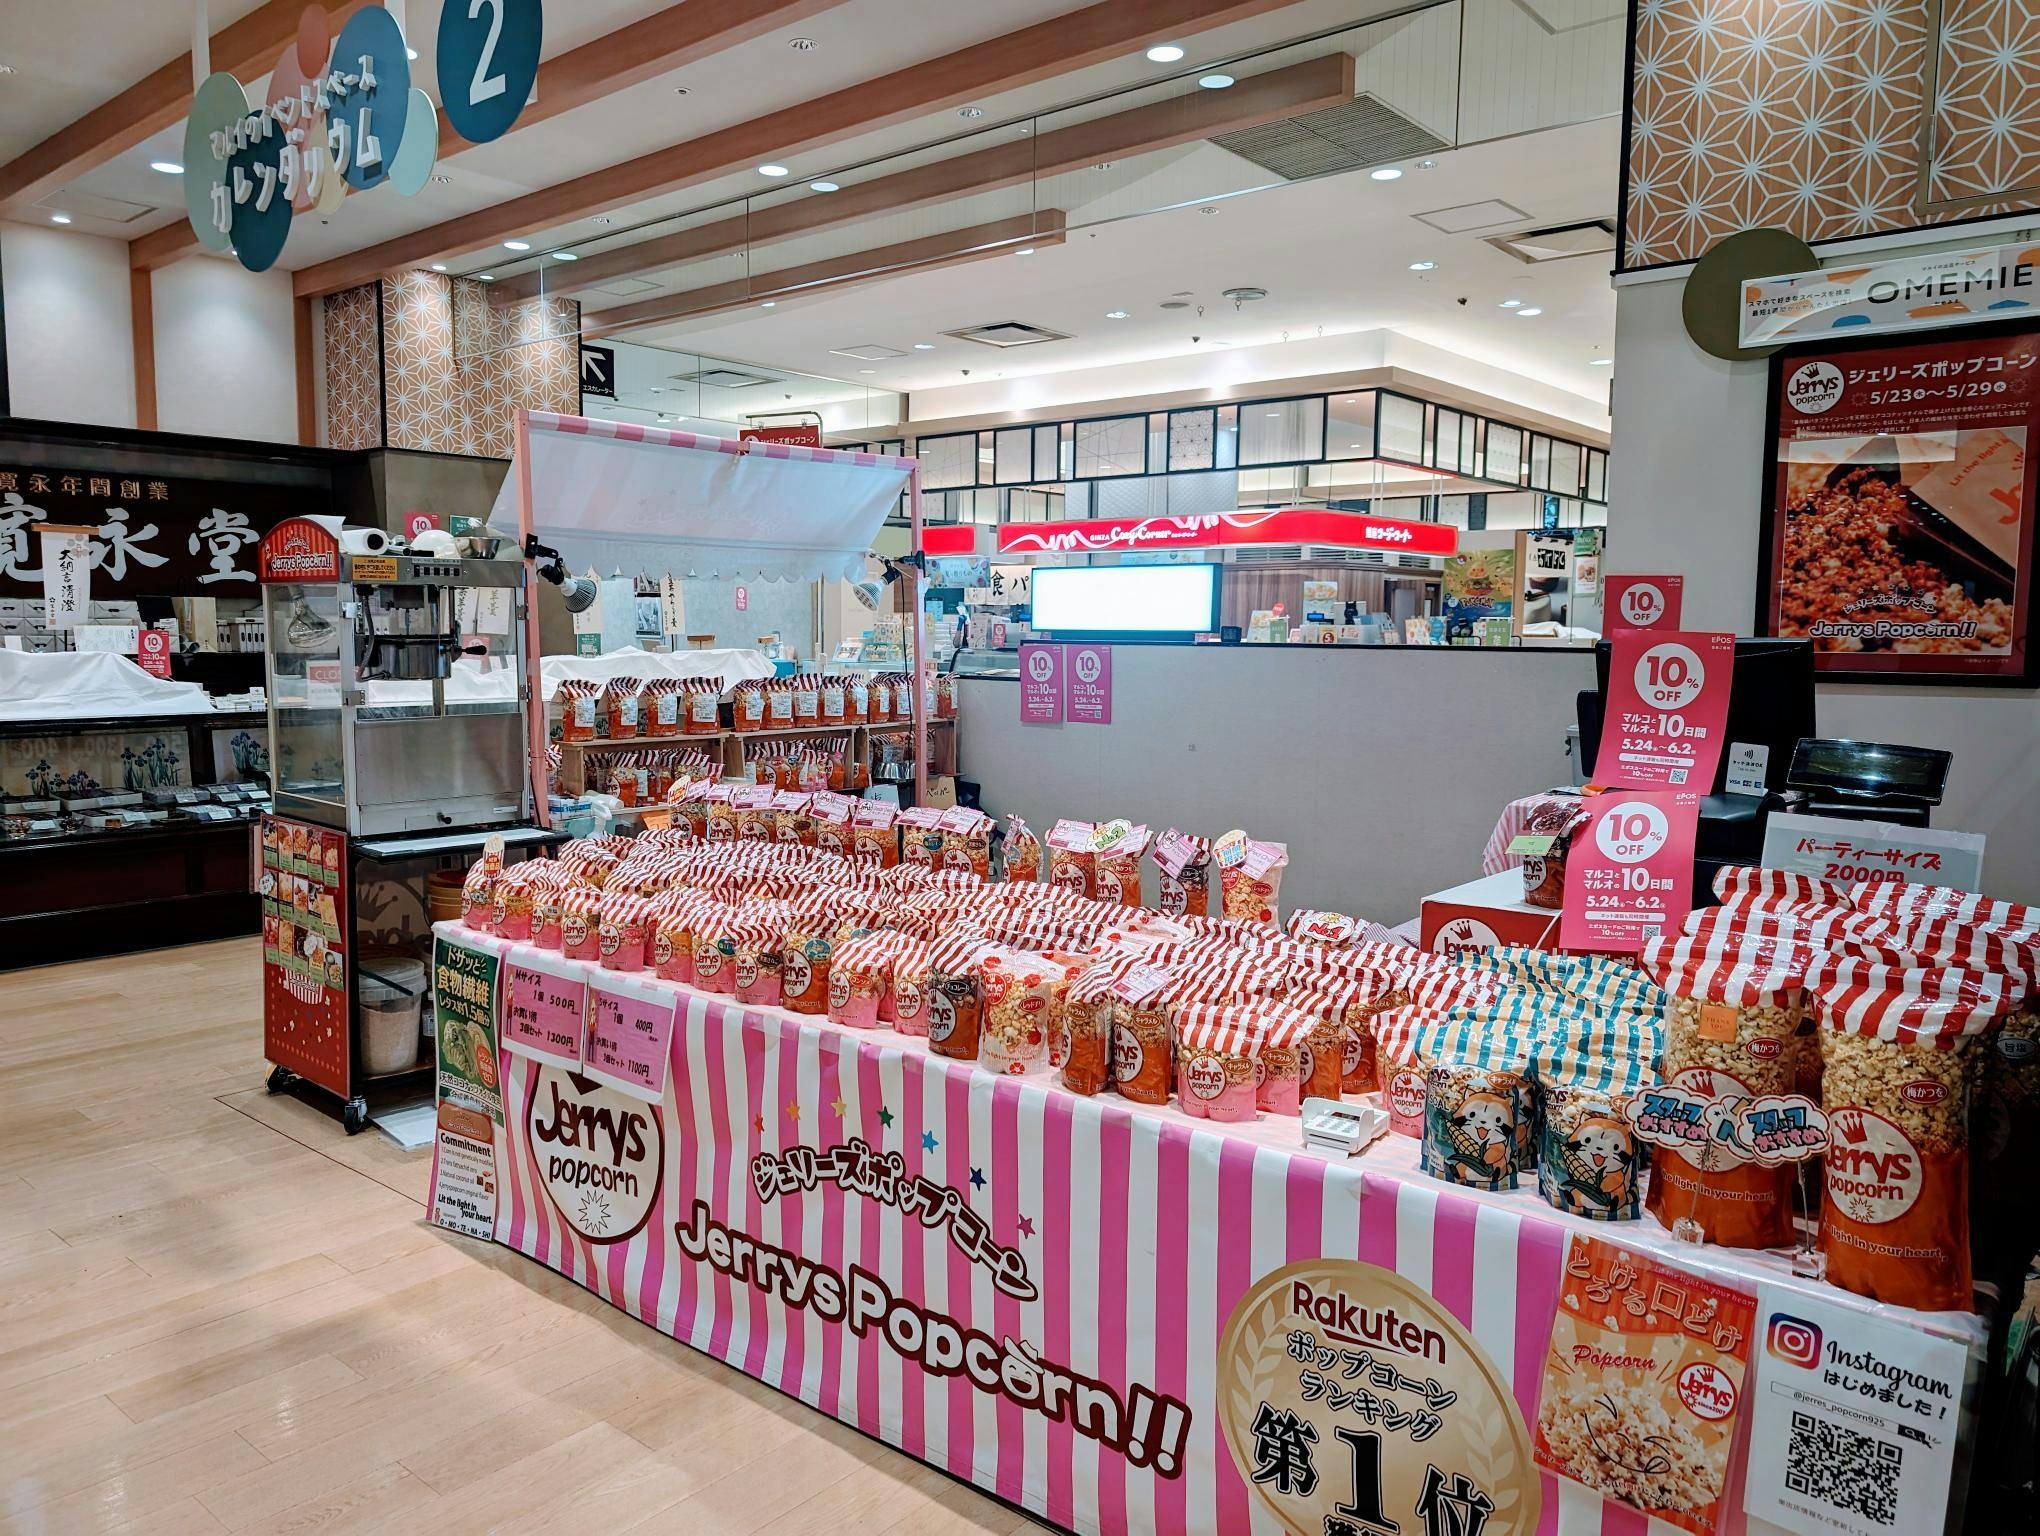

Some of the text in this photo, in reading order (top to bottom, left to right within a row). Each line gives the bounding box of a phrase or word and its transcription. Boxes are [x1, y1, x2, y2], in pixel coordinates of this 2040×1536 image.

[468, 0, 506, 106] 2
[211, 107, 383, 234] カレンダリウム
[1867, 263, 2033, 304] OMEMIE
[1848, 353, 2037, 385] ジェリーズポップコーン
[582, 384, 613, 394] エスカレーター
[1789, 375, 1839, 397] Jerrys
[1795, 392, 1835, 406] popcorn
[1138, 526, 1172, 540] Corner
[272, 552, 296, 570] Jerrys
[295, 551, 333, 570] Popcorn!!
[1627, 591, 1662, 612] 10%
[1633, 613, 1651, 621] OFF
[1711, 636, 1731, 644] EPOS
[1810, 620, 1978, 638] Jerrys Popcorn!!
[315, 670, 342, 679] CLOS
[1646, 655, 1699, 689] 10%
[1654, 690, 1681, 702] OFF
[1621, 723, 1655, 734] マルオの
[1622, 713, 1657, 723] マルコと
[1658, 714, 1707, 738] 10日間
[1095, 826, 1126, 850] No.2
[1609, 813, 1662, 842] 10%
[1616, 845, 1644, 855] OFF
[1796, 838, 1942, 872] パーティーサイズ
[1584, 869, 1620, 879] マルコと
[1621, 867, 1674, 891] 10日間
[1824, 863, 1905, 883] 2000円
[1584, 879, 1620, 890] マルオの
[564, 925, 586, 937] Jerrys
[1307, 923, 1344, 939] No.1
[447, 945, 480, 975] ドサッと
[437, 965, 490, 1009] 食物繊維
[515, 969, 541, 987] Mサイズ
[533, 990, 575, 1010] 1個 500円
[513, 1006, 537, 1023] お買い得
[613, 1012, 653, 1034] 1個 400円
[1135, 1016, 1158, 1025] キャラメル
[1706, 1017, 1730, 1025] THANK
[519, 1022, 574, 1048] 3個セット 1300円
[628, 1059, 650, 1077] 1100円
[1227, 1060, 1250, 1070] キャラメル
[1267, 1052, 1292, 1063] キャラメル
[1188, 1065, 1223, 1084] Jerrys
[1191, 1082, 1220, 1092] popcorn
[1391, 1085, 1425, 1101] Jerrys
[1906, 1085, 1944, 1098] 梅かつを
[1394, 1099, 1423, 1109] popcorn
[1644, 1094, 1703, 1122] スタッフ
[535, 1081, 647, 1167] Jerrys
[1637, 1114, 1708, 1141] おすすめ
[1747, 1106, 1807, 1134] スタッフ
[440, 1133, 491, 1157] Commitment
[1753, 1128, 1827, 1152] おすすめ
[549, 1155, 638, 1197] popcorn
[1830, 1174, 1904, 1200] popcorn
[1674, 1174, 1697, 1191] light
[1700, 1183, 1711, 1195] in
[1714, 1190, 1742, 1201] your
[438, 1194, 477, 1212] Lit the light in
[461, 1208, 493, 1225] your heart.
[752, 1138, 1037, 1300] ジェリーズポップコーン
[1831, 1225, 1852, 1243] light
[1854, 1236, 1867, 1248] in
[1869, 1242, 1902, 1258] your
[1680, 1274, 1699, 1288] light
[1700, 1281, 1709, 1290] in
[1711, 1286, 1731, 1299] your
[1293, 1281, 1446, 1364] Rakuten
[676, 1202, 1191, 1478] Jerrys Popcorn!!
[1572, 1344, 1657, 1371] Popcorn
[1287, 1330, 1457, 1412] ポップコーン
[1826, 1340, 1952, 1399] Instagram
[1681, 1371, 1733, 1408] Jerrys
[1824, 1369, 1947, 1421] はじめました！
[1300, 1369, 1442, 1442] ランキング
[1251, 1401, 1495, 1536] 第1位
